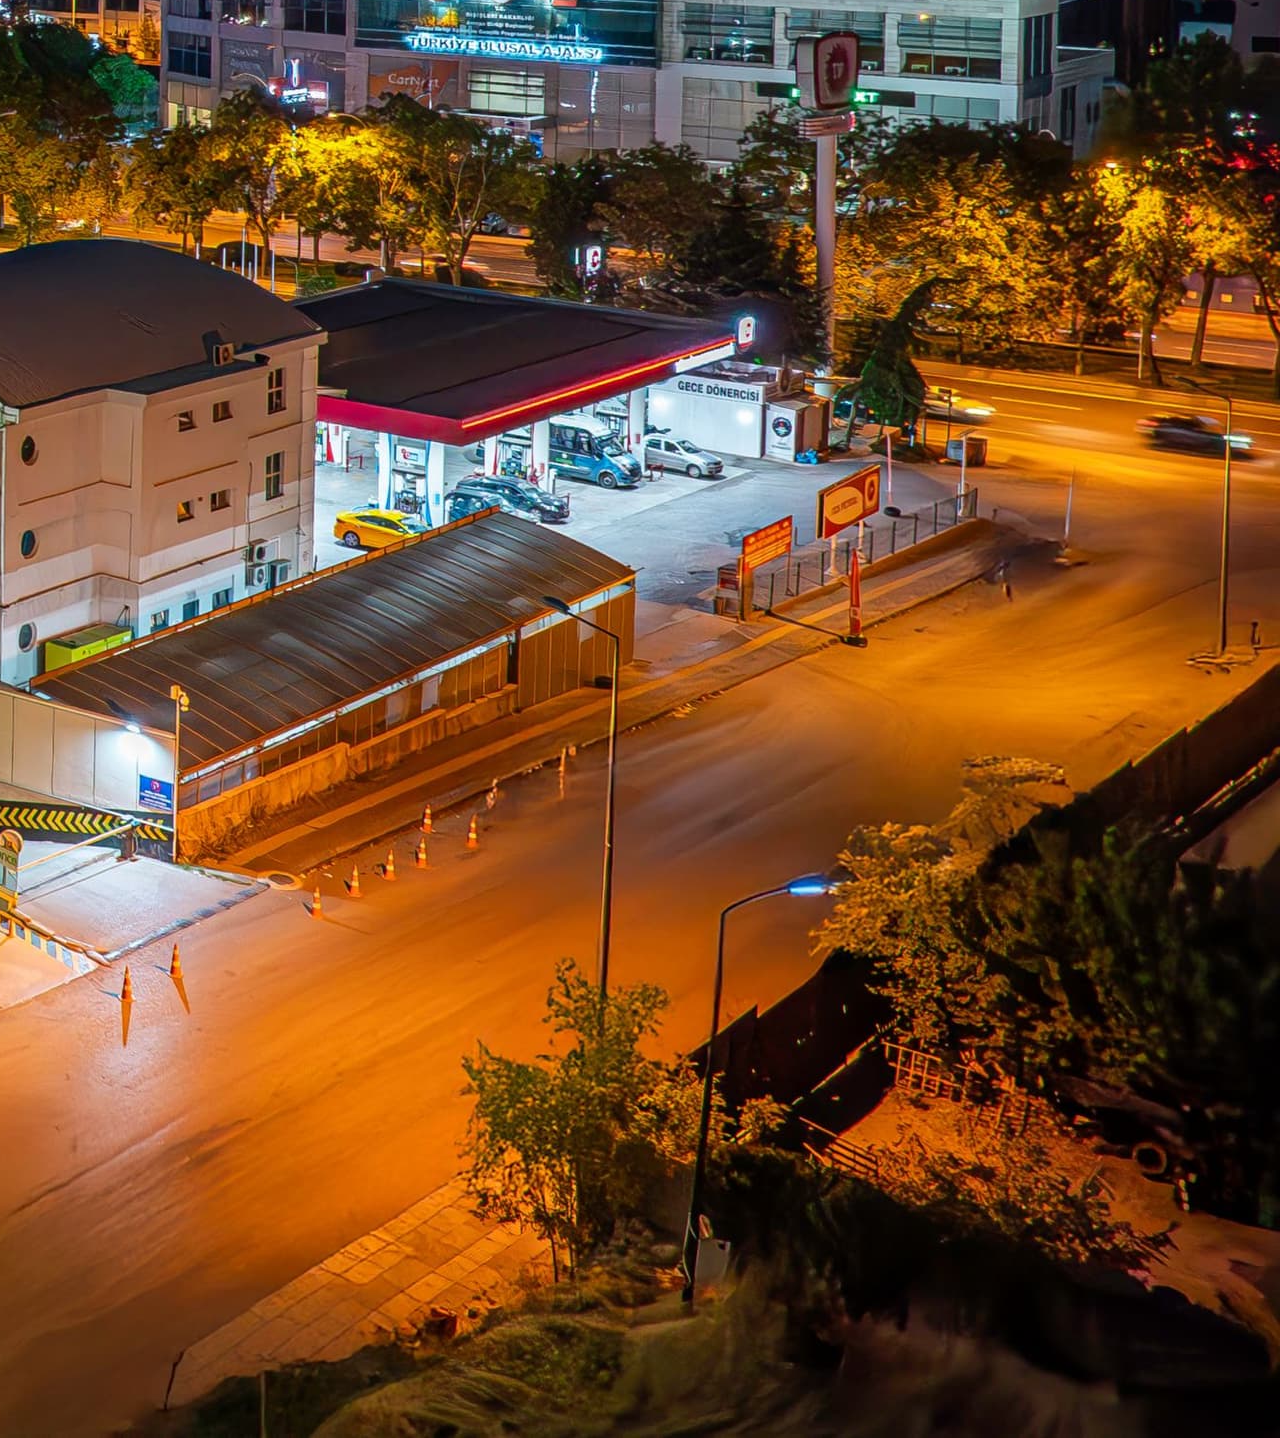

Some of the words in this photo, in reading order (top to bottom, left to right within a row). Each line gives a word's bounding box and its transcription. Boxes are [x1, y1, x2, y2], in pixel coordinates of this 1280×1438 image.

[408, 33, 476, 50] TÜRKİYE
[478, 40, 538, 56] ULUSAL
[542, 46, 601, 60] AJANSI
[677, 380, 703, 394] GECE
[706, 383, 760, 402] DÖNERCİSİ
